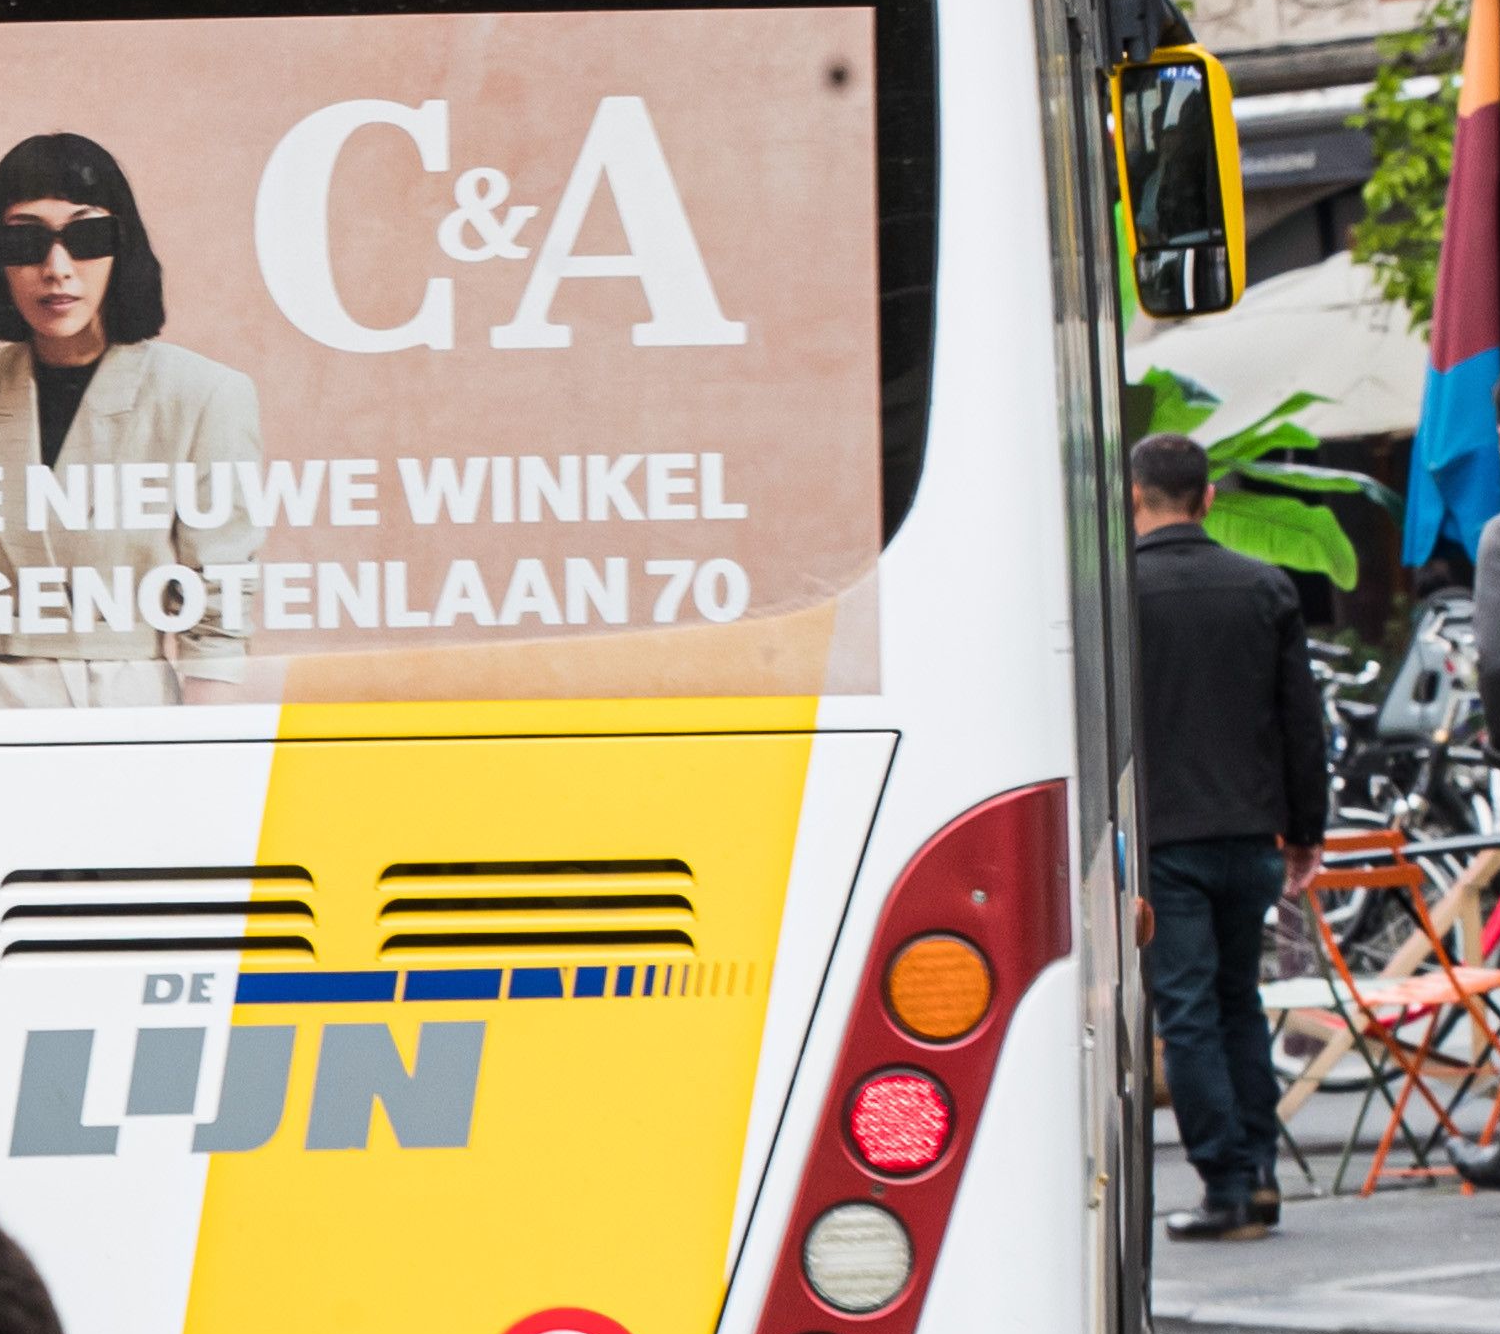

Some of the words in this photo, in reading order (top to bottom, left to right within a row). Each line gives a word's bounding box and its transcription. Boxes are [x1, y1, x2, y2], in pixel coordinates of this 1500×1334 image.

[254, 95, 748, 353] C&A
[25, 456, 381, 533] NIEUWE
[397, 452, 749, 525] WINKEL
[645, 557, 751, 624] 70
[141, 972, 216, 1005] DE
[8, 1020, 487, 1157] LIJN
